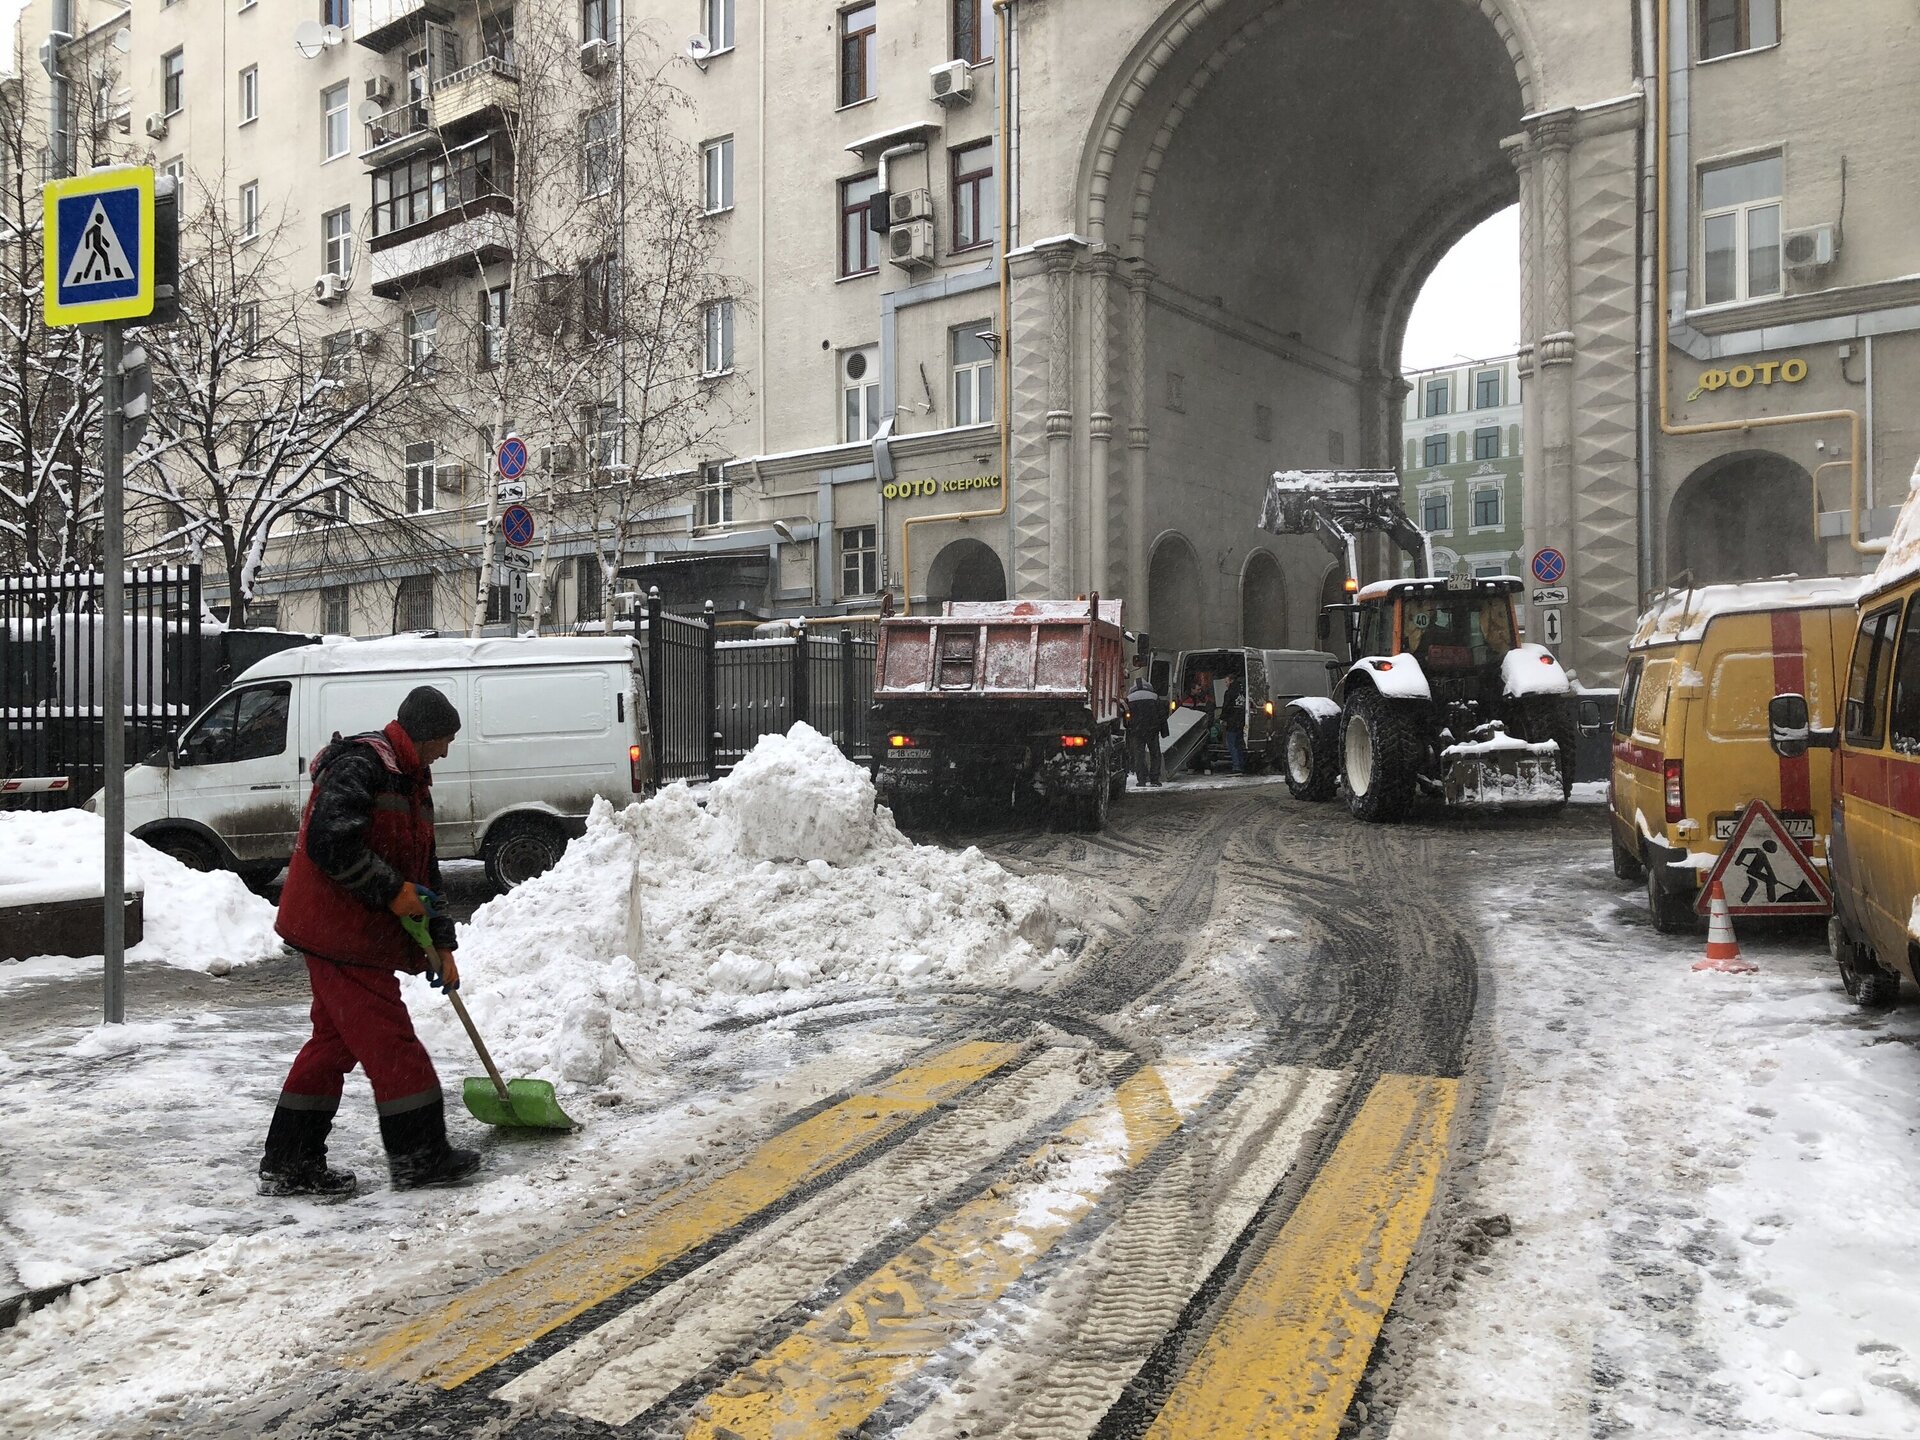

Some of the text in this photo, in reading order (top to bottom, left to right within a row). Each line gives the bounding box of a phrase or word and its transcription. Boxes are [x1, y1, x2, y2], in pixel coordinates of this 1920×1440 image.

[1698, 358, 1808, 391] ФОТО
[883, 475, 1000, 499] ФОТО КСЕРОКС
[513, 592, 523, 603] 10
[1416, 615, 1427, 626] 40
[1785, 820, 1808, 832] 777
